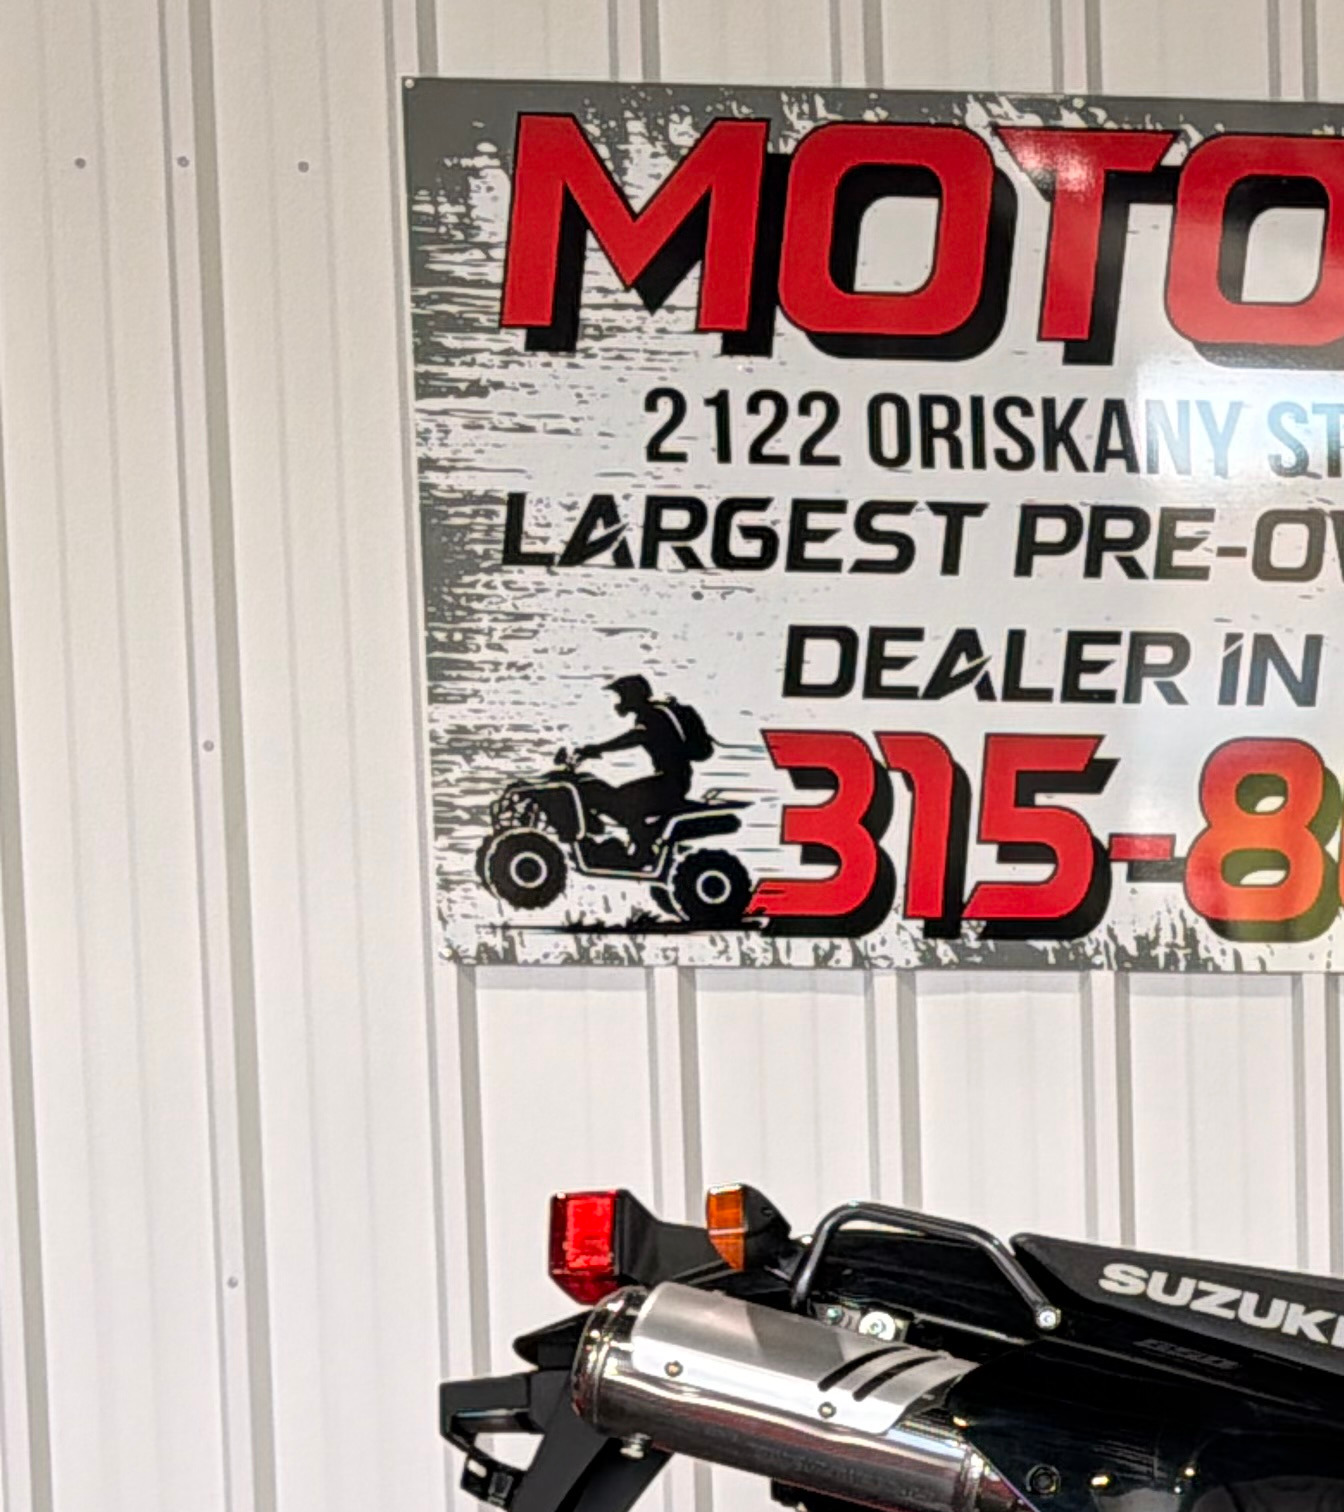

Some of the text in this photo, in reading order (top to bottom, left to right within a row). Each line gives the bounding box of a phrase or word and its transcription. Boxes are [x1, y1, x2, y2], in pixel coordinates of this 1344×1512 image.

[643, 386, 842, 468] 2122
[867, 390, 1243, 475] ORISKANY
[500, 491, 990, 575] LARGEST
[782, 624, 1192, 706] DEALER
[1218, 632, 1324, 708] IN
